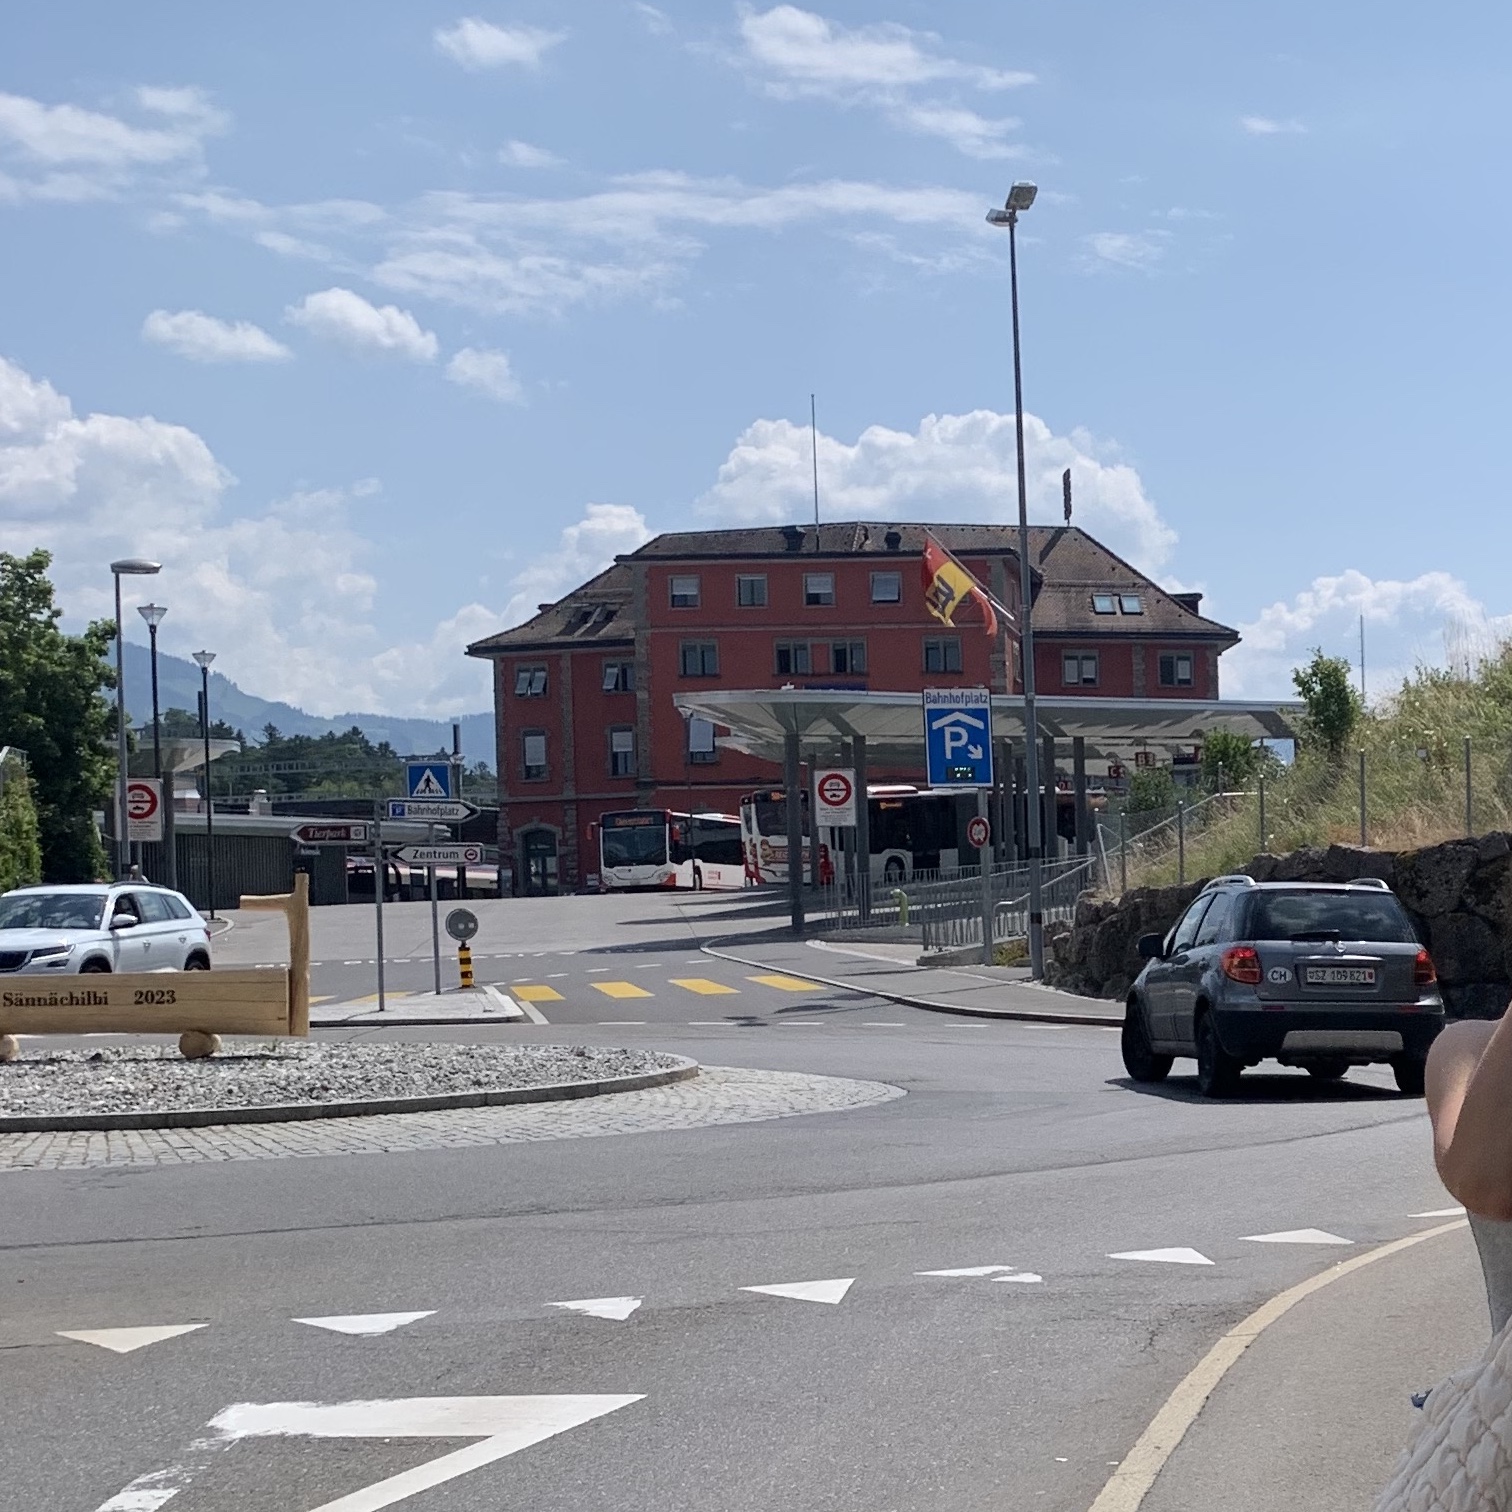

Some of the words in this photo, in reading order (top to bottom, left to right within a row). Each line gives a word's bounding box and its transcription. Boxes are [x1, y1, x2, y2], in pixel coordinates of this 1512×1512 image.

[926, 691, 988, 706] Bahnhofplatz
[407, 806, 460, 817] Bahnhofplatz
[308, 827, 347, 840] Tierpark
[412, 849, 460, 859] Zentrum
[1271, 970, 1287, 981] CH
[2, 991, 109, 1007] Sännächilbi
[134, 989, 177, 1005] 2023
